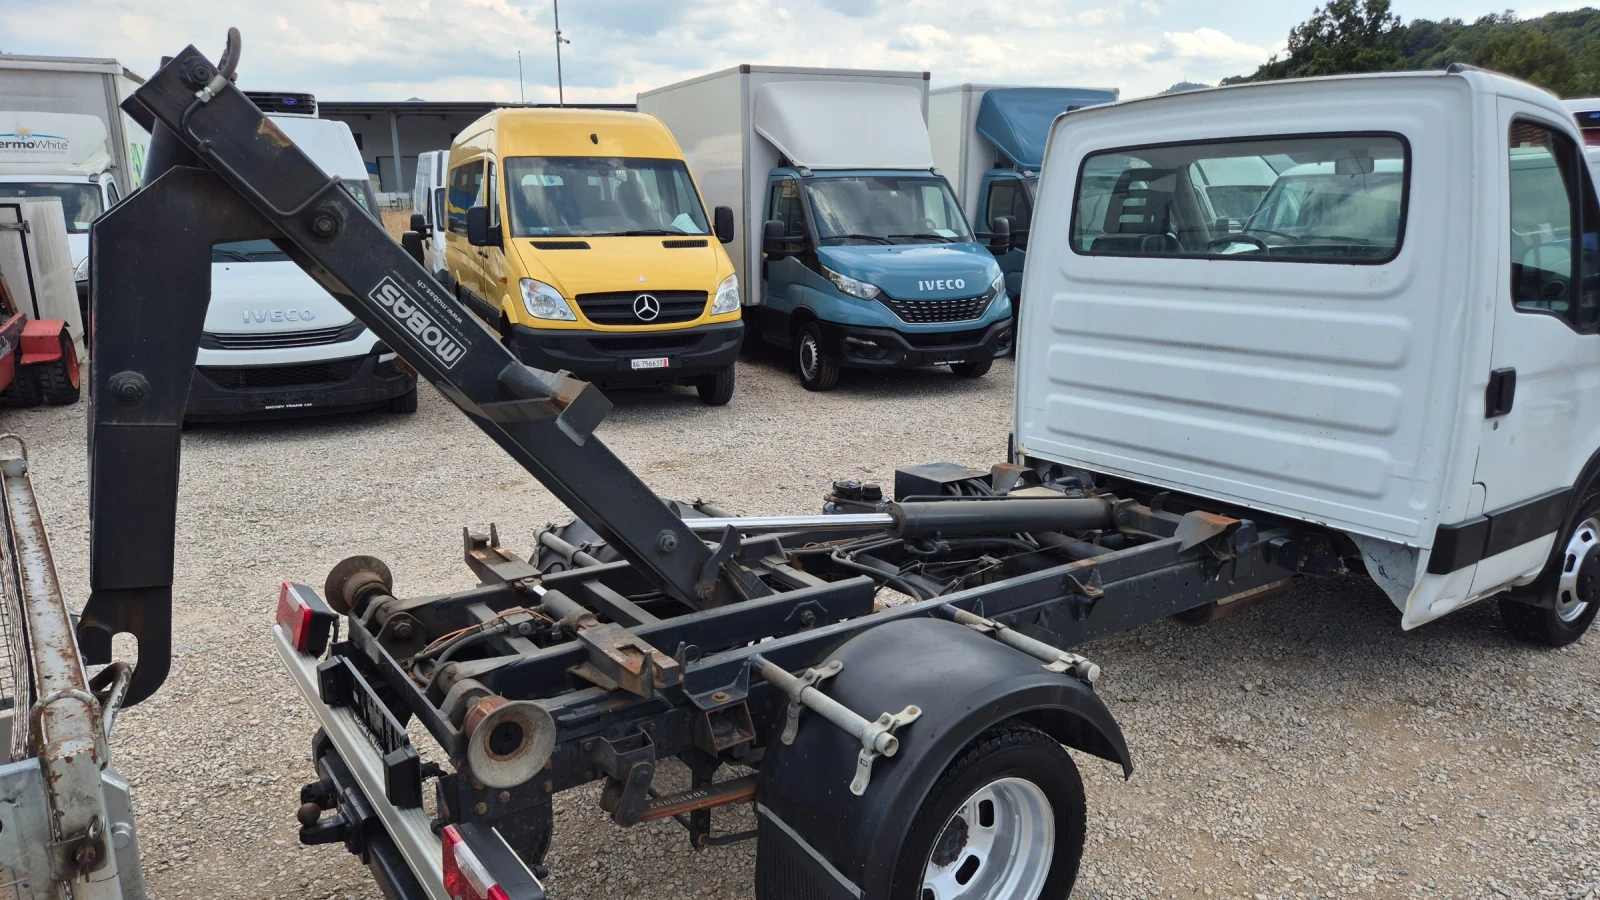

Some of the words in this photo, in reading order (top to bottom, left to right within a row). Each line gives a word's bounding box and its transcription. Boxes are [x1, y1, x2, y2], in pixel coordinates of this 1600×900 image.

[918, 278, 966, 292] IVECO
[243, 308, 316, 323] IVECO
[417, 279, 463, 324] www.mobas.ch
[376, 284, 462, 362] MOBAS
